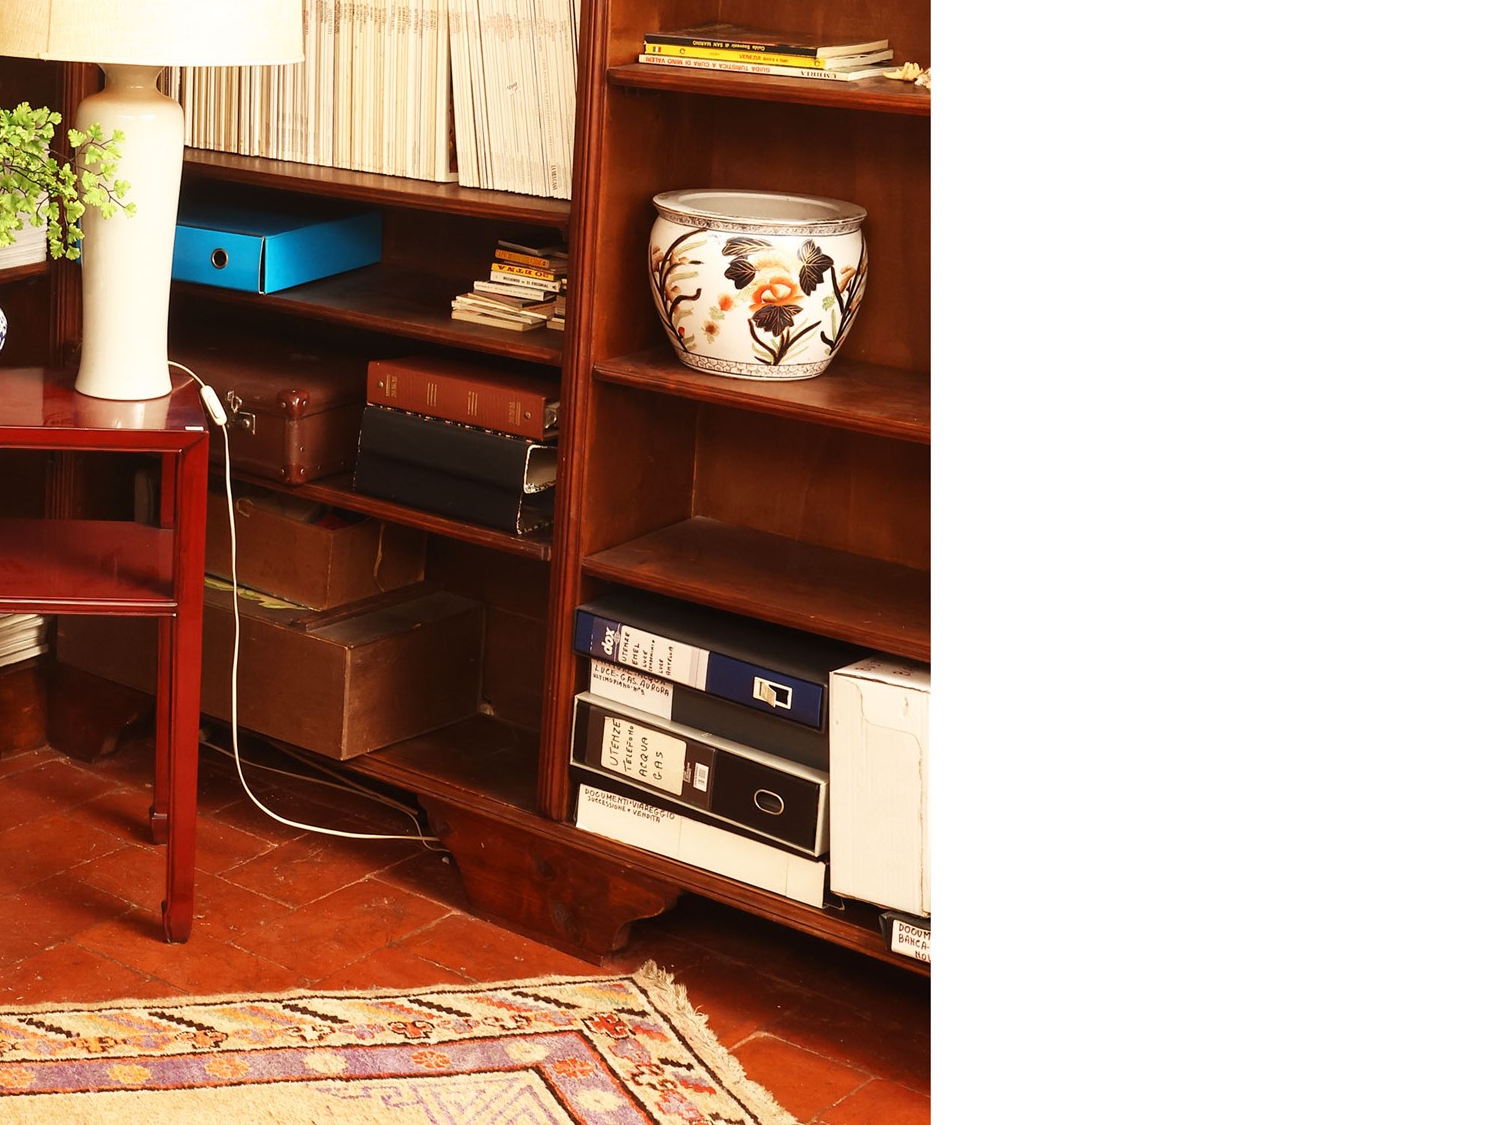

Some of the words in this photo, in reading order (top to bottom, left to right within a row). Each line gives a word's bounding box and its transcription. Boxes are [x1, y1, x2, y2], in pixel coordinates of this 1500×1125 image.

[730, 42, 751, 50] Souvenir
[644, 56, 666, 65] VALERI
[666, 57, 683, 65] MINO
[717, 63, 749, 72] TURISTICA
[750, 65, 771, 73] GUIDA
[799, 69, 837, 79] UMBRIA
[601, 626, 616, 656] dox
[639, 679, 670, 697] AURORA
[609, 717, 622, 767] UTENZE
[622, 724, 635, 773] TELEFONO
[638, 736, 649, 777] ACQUA
[652, 750, 664, 781] GAS
